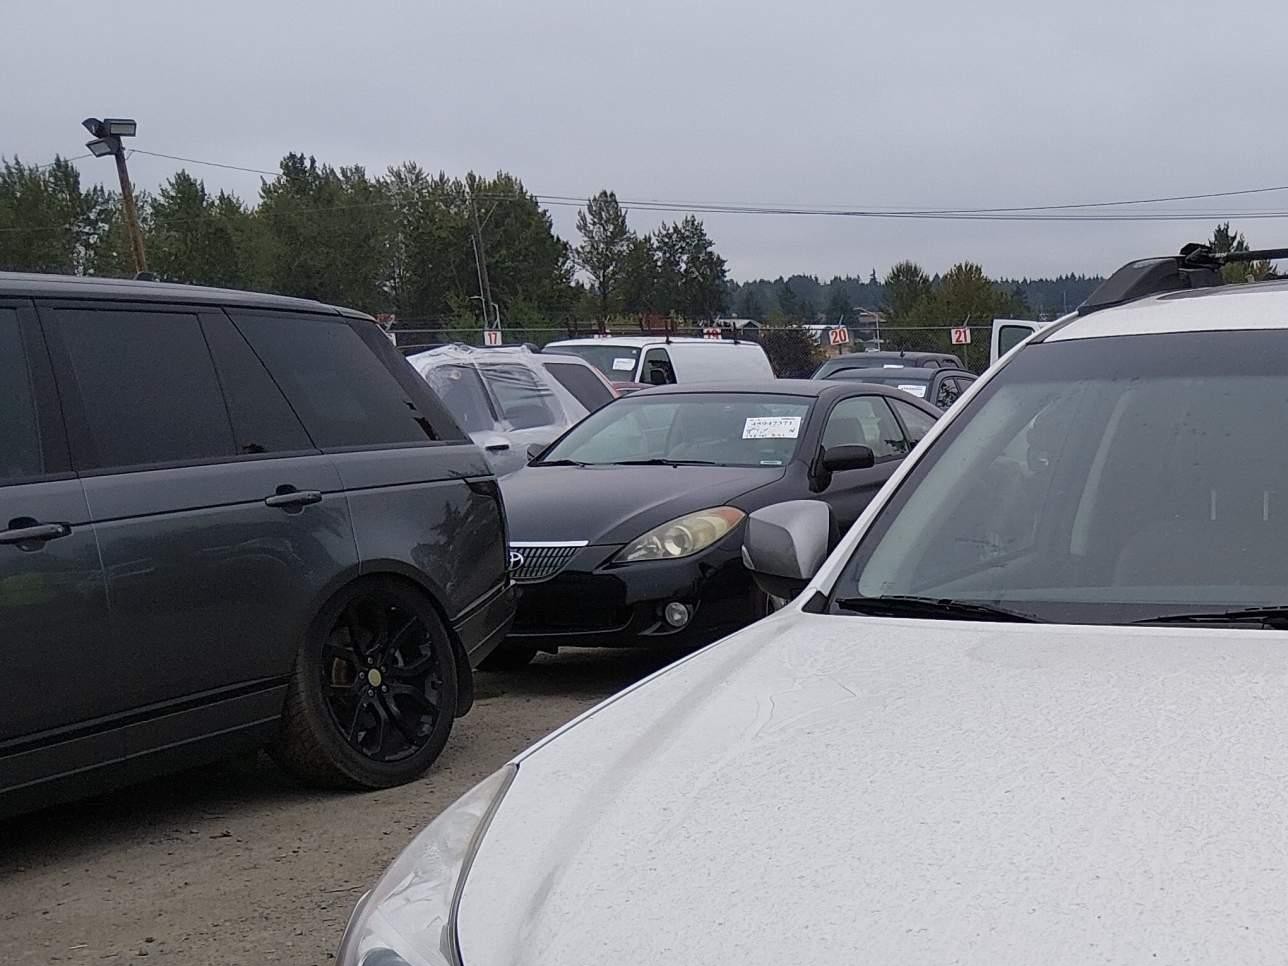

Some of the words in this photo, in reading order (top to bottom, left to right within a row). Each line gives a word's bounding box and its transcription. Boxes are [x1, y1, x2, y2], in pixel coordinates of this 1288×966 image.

[488, 332, 498, 345] 17
[831, 329, 847, 344] 20
[955, 329, 968, 343] 21
